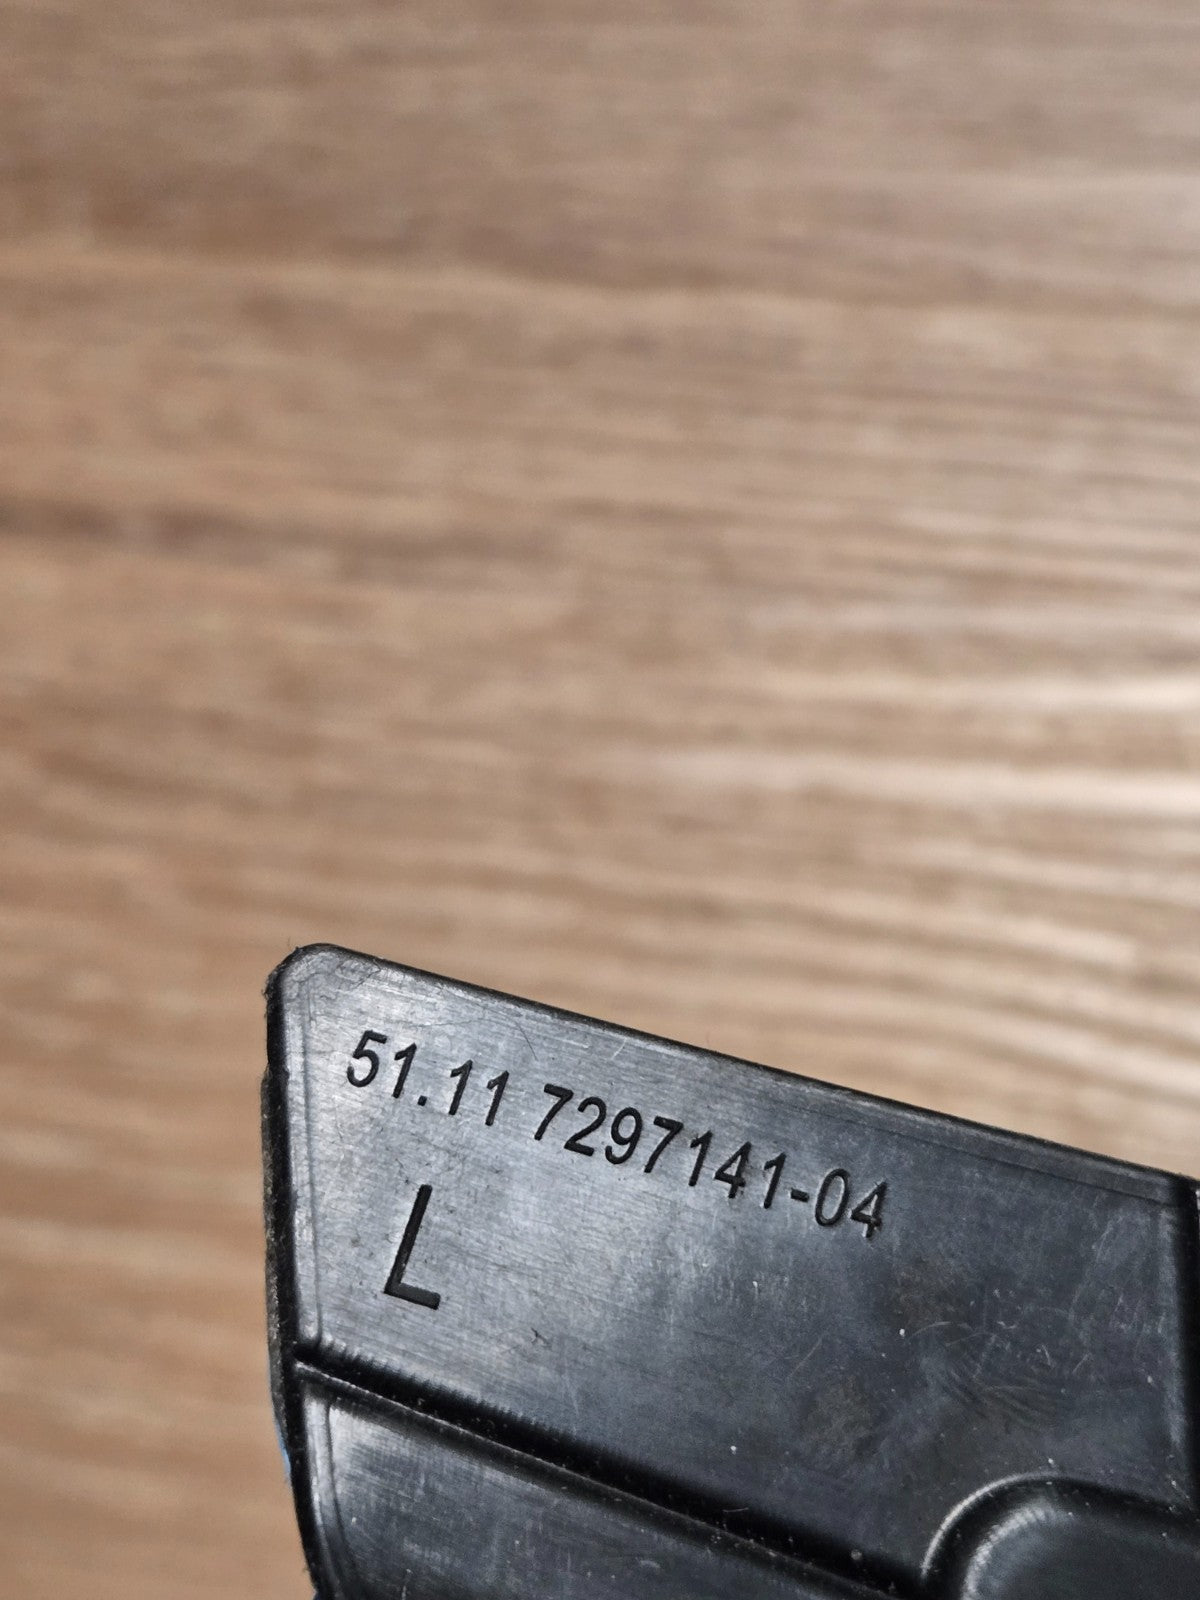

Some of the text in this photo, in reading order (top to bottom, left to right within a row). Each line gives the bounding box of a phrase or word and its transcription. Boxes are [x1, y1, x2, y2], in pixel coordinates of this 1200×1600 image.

[346, 1030, 889, 1238] 51.11 7297141-04
[383, 1184, 441, 1310] L
